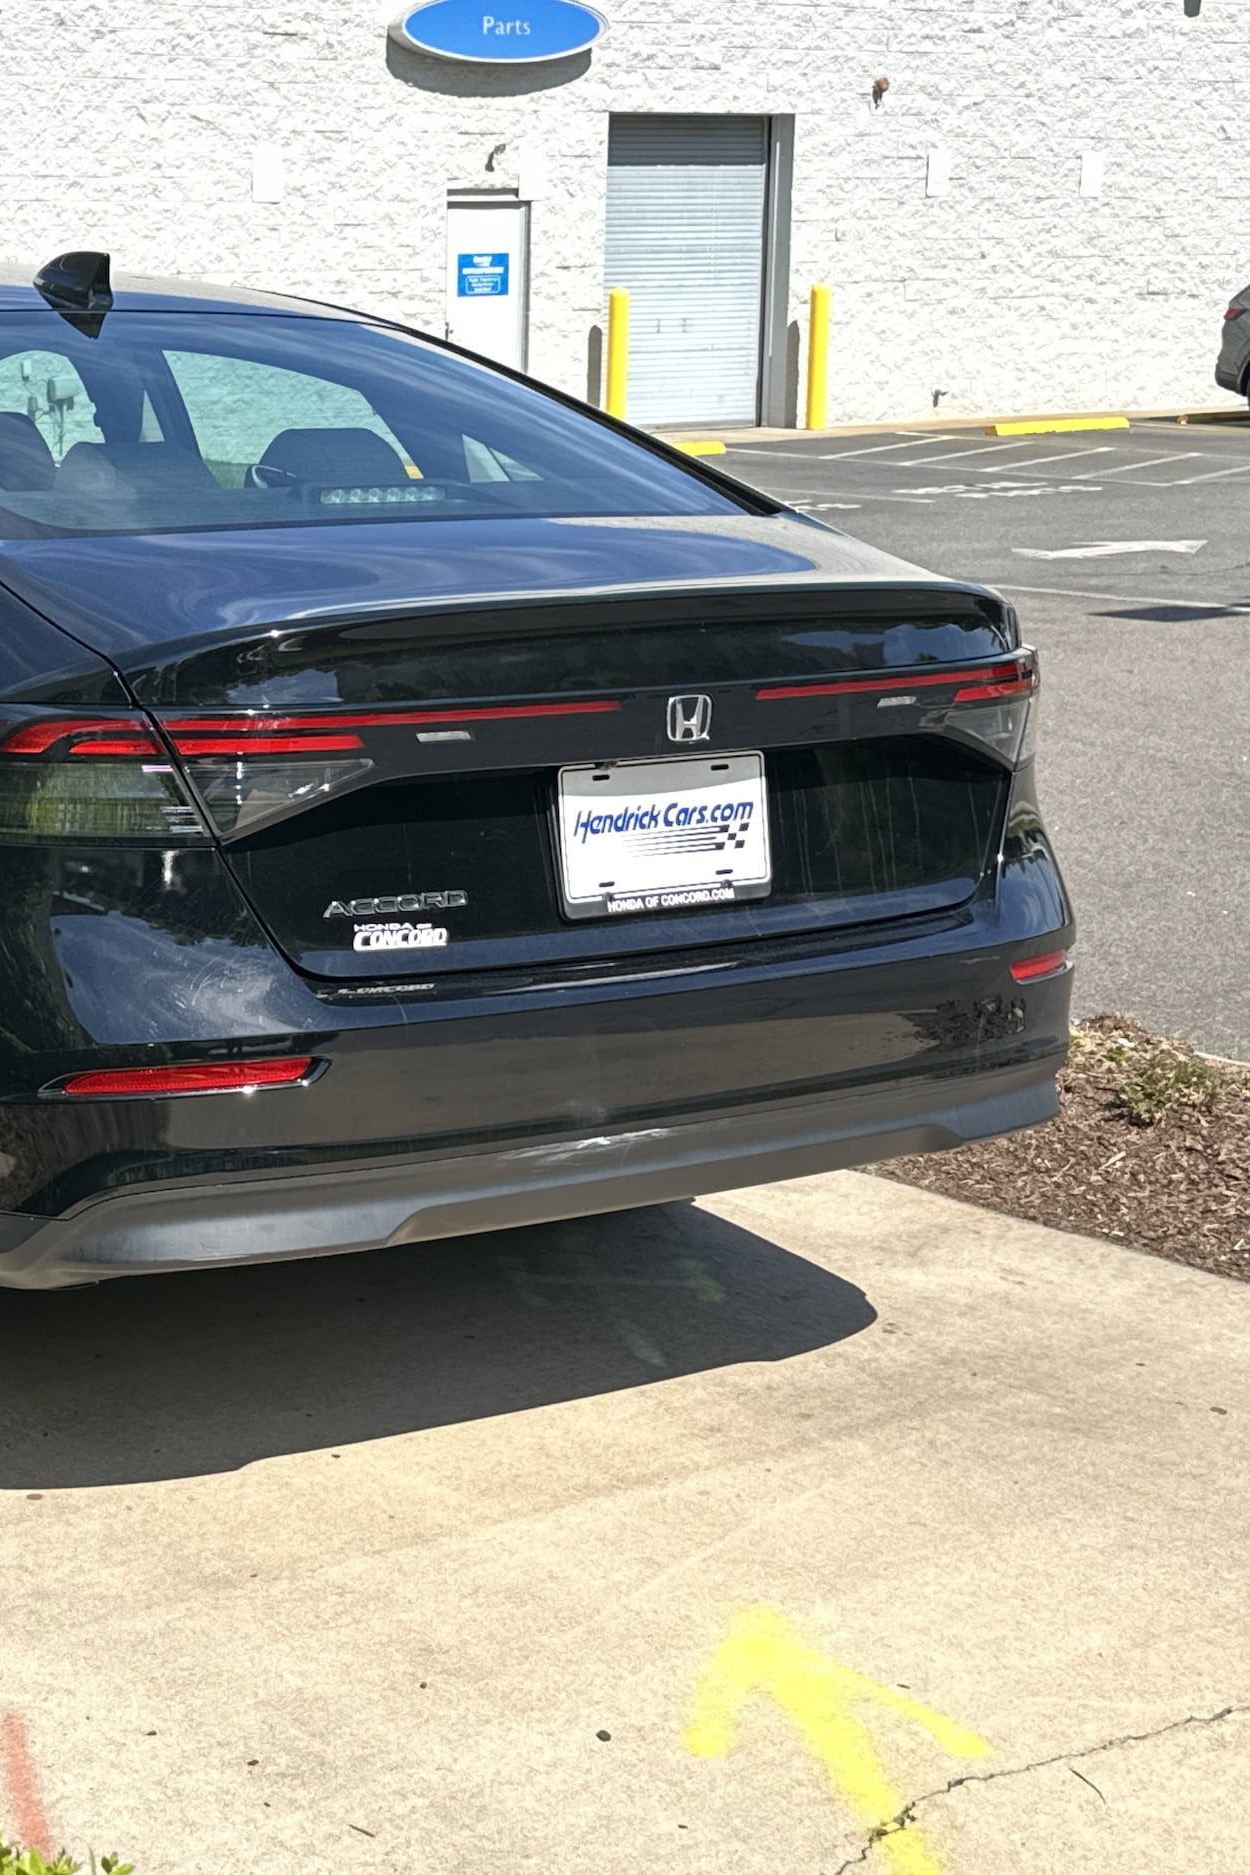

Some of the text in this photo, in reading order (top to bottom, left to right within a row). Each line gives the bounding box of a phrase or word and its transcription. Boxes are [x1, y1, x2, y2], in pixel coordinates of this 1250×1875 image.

[482, 15, 531, 36] Parts
[322, 889, 469, 919] ACCORD
[607, 887, 735, 912] HONDA OF CONCORD.COM
[353, 923, 414, 932] HONDA
[353, 928, 448, 952] CONCORD
